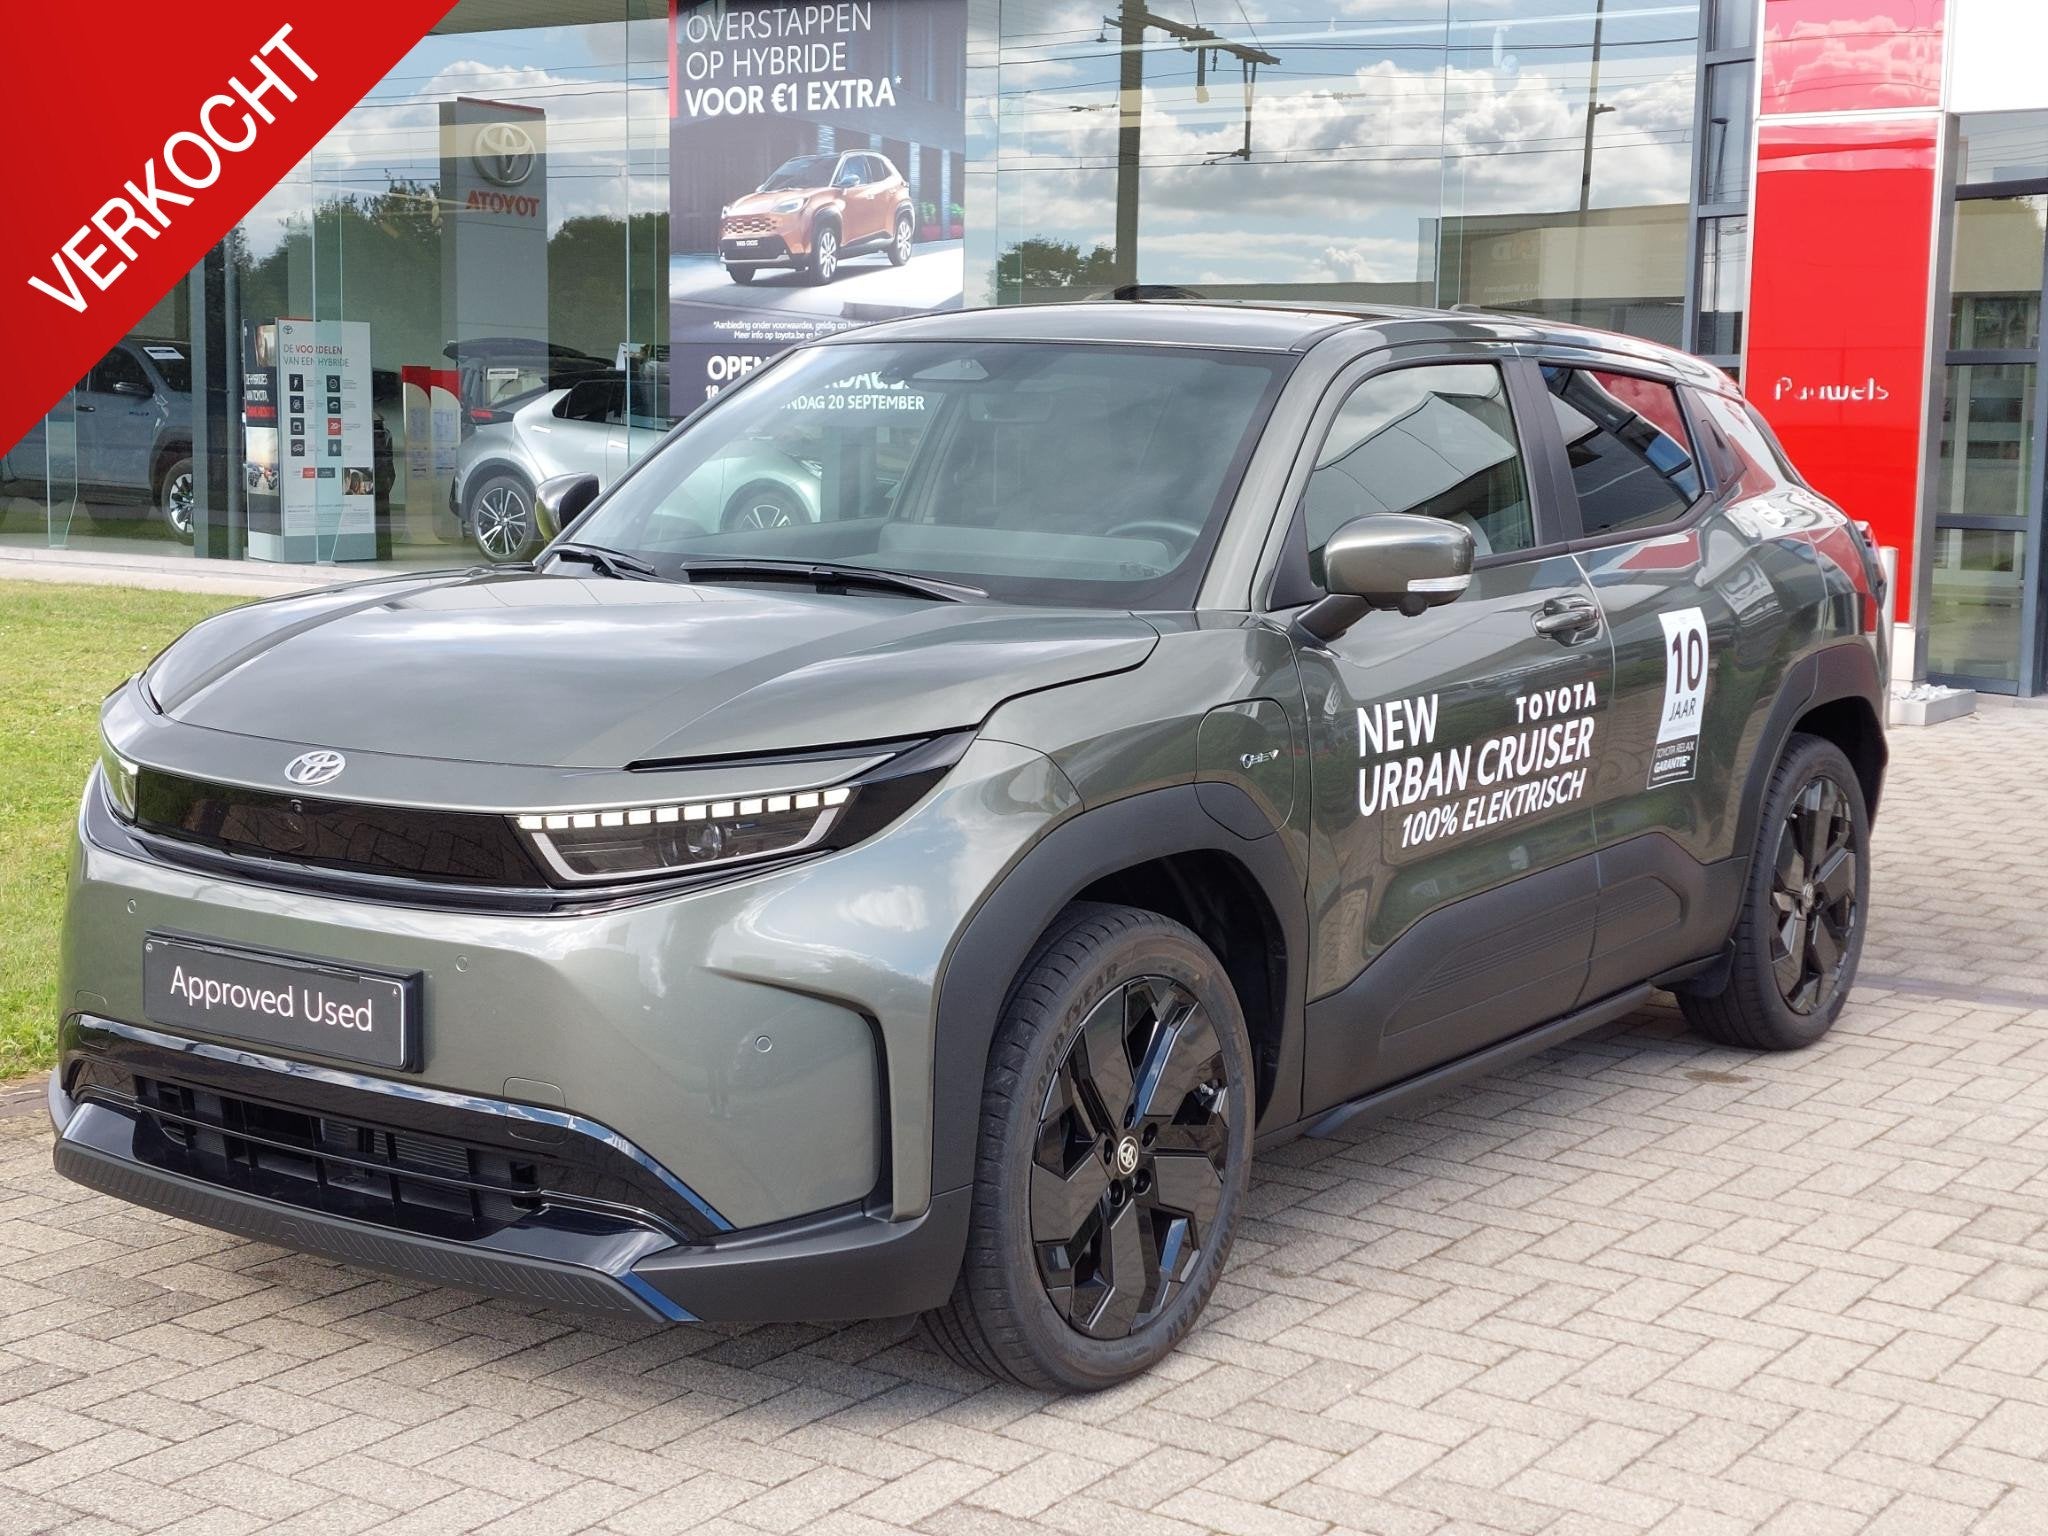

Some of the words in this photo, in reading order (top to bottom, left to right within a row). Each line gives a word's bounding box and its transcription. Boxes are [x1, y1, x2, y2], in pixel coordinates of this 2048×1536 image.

[686, 2, 871, 43] OVERSTAPPEN
[686, 51, 724, 80] OP
[733, 42, 846, 77] HYBRIDE
[685, 85, 765, 117] VOOR
[771, 82, 798, 112] €1
[734, 331, 750, 339] Meer
[751, 331, 763, 339] info
[765, 332, 774, 341] op
[775, 331, 805, 341] toyota.be
[752, 321, 771, 330] onder
[815, 321, 836, 331] geldig
[283, 344, 294, 353] DE
[284, 356, 299, 365] VAN
[828, 394, 845, 409] 20
[847, 394, 925, 410] SEPTEMBER
[1672, 628, 1703, 695] 10
[1516, 681, 1597, 723] TOYOTA
[1668, 697, 1697, 722] JAAR
[1357, 694, 1438, 757] NEW
[1359, 745, 1472, 817] URBAN
[1477, 716, 1595, 786] CRUISER
[1402, 802, 1459, 849] 100%
[1462, 767, 1588, 832] ELEKTRISCH
[170, 965, 294, 1018] Approved
[304, 989, 372, 1032] Used
